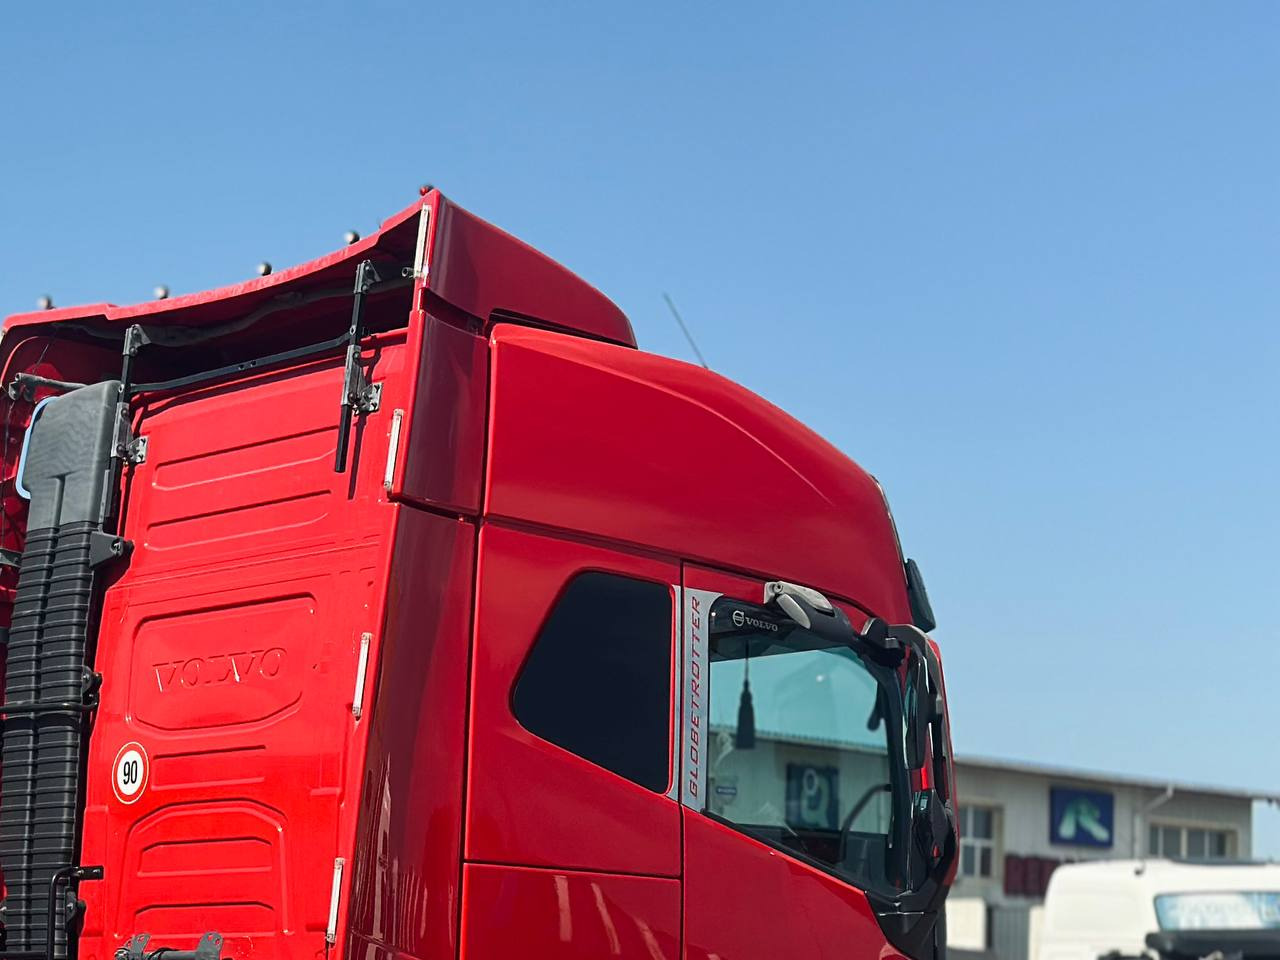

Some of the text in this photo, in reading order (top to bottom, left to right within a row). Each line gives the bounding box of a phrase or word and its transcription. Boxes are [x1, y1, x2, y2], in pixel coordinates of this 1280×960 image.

[745, 616, 778, 632] VOLVO
[152, 647, 288, 693] VOLVO
[689, 596, 701, 799] GLOBETROTTER
[123, 760, 138, 785] 90
